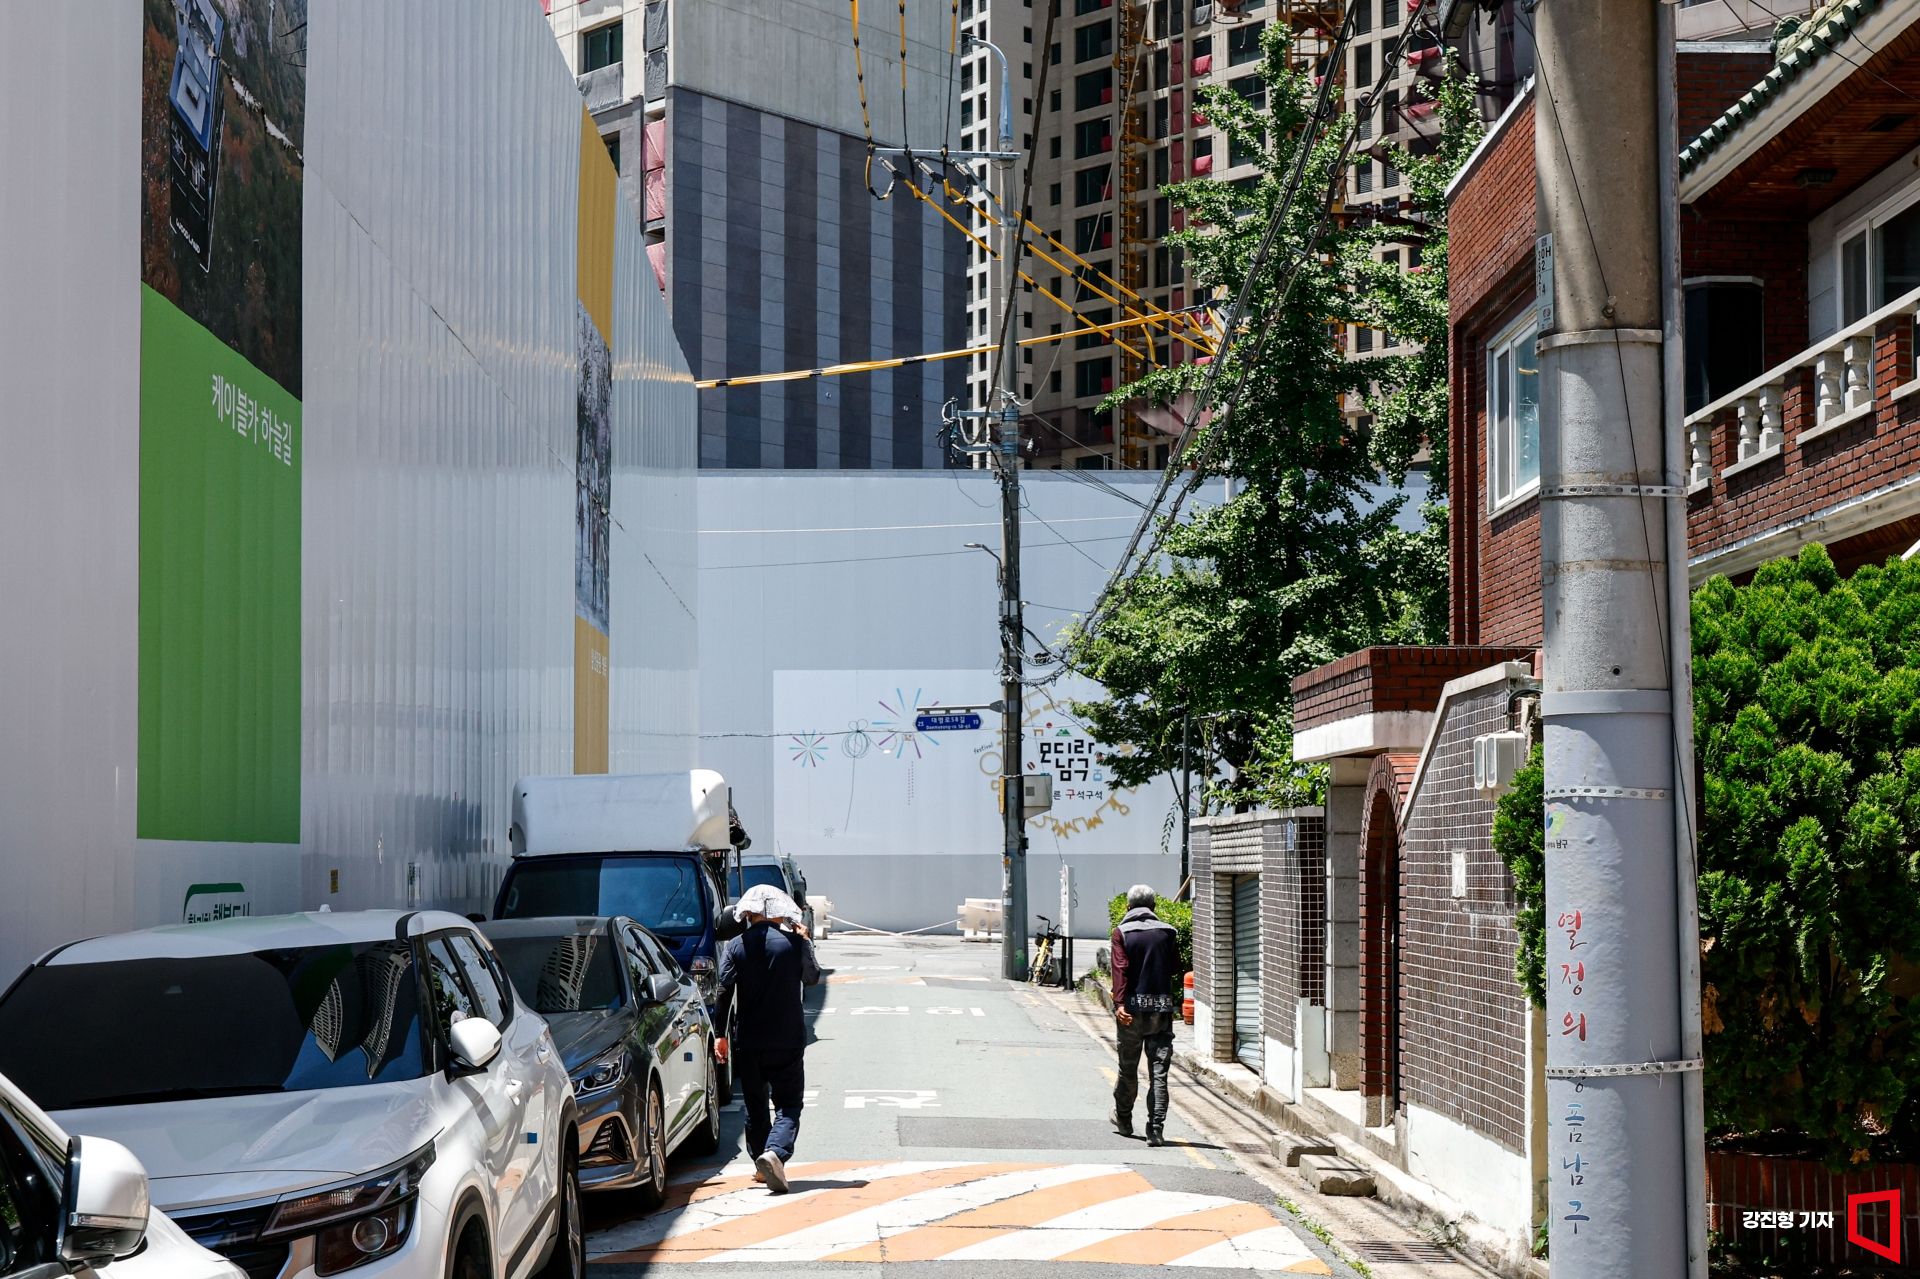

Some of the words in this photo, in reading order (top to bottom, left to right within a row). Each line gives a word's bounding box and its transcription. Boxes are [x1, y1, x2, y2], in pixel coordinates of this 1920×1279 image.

[212, 374, 259, 445] 케이블카
[261, 406, 291, 467] 하늘길
[1055, 758, 1089, 781] 남구
[1065, 789, 1103, 800] 구석구석
[1557, 910, 1588, 1041] 열정의
